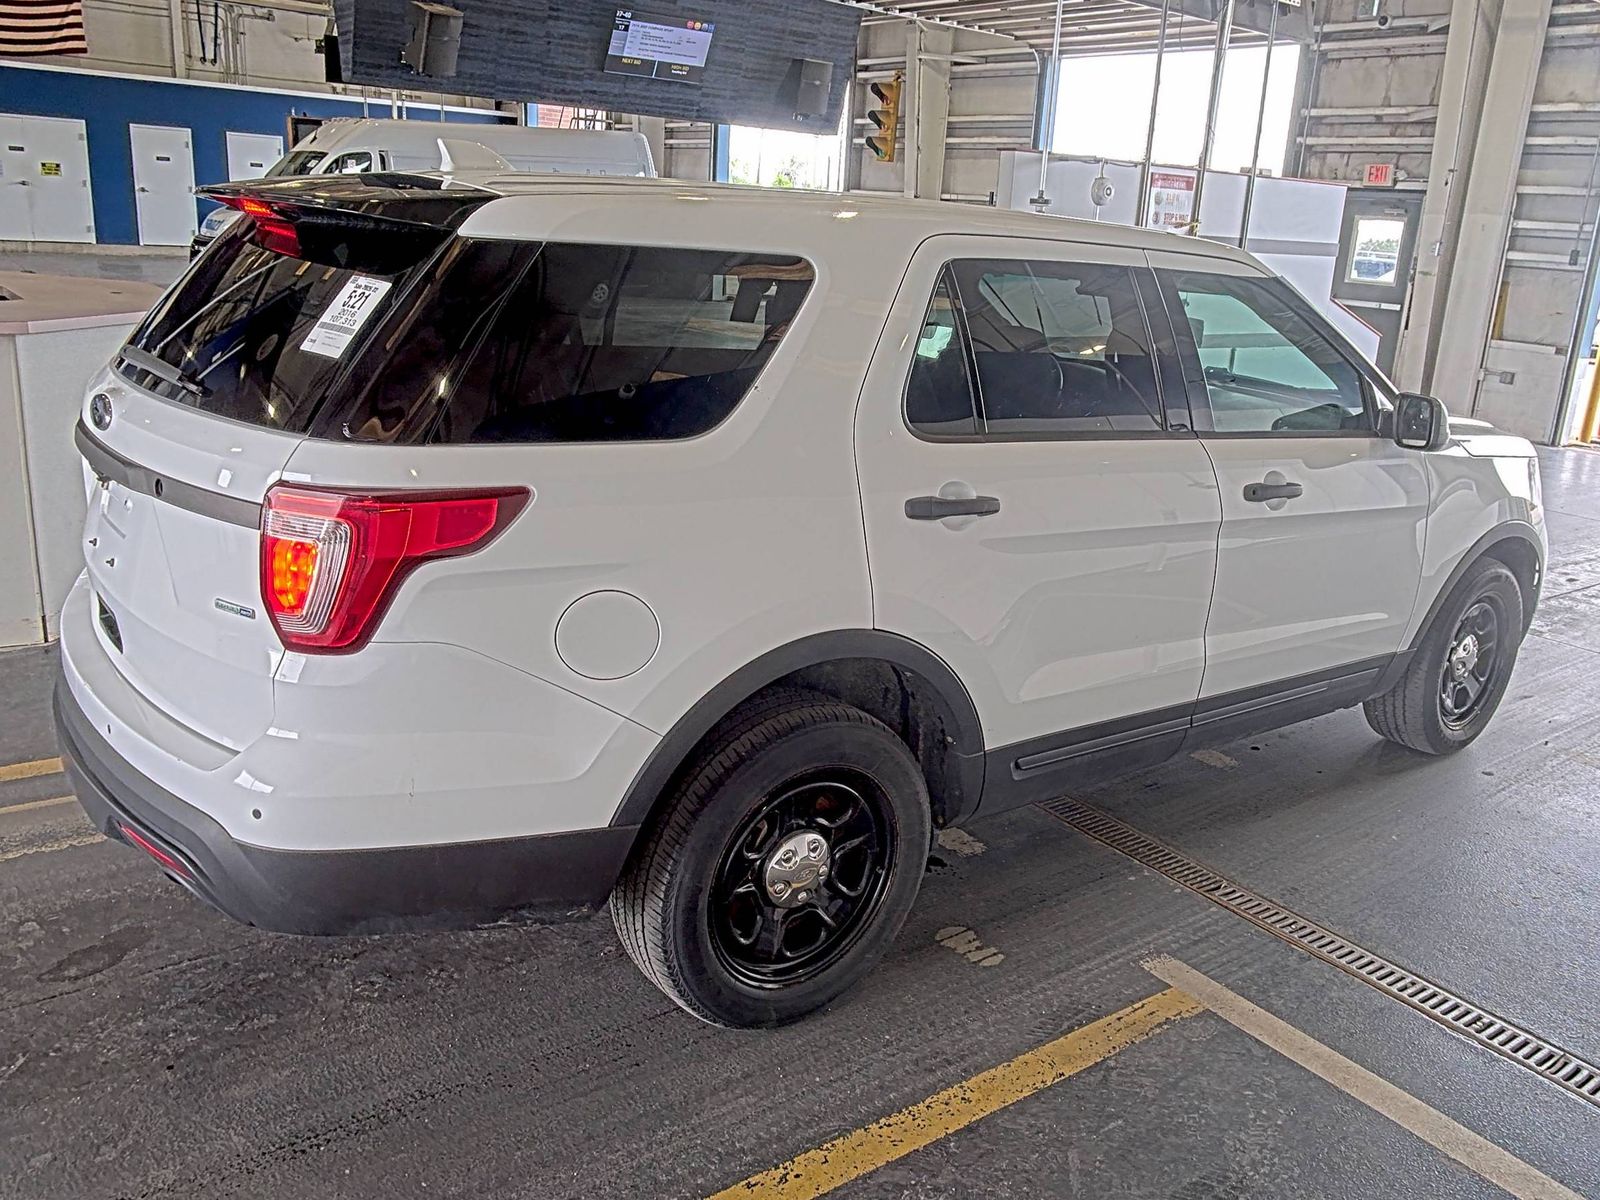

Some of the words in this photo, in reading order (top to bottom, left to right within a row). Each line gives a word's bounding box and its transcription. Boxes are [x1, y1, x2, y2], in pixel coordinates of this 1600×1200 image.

[1368, 165, 1390, 183] EXIT
[342, 290, 371, 310] 5:21
[338, 308, 358, 318] 2016
